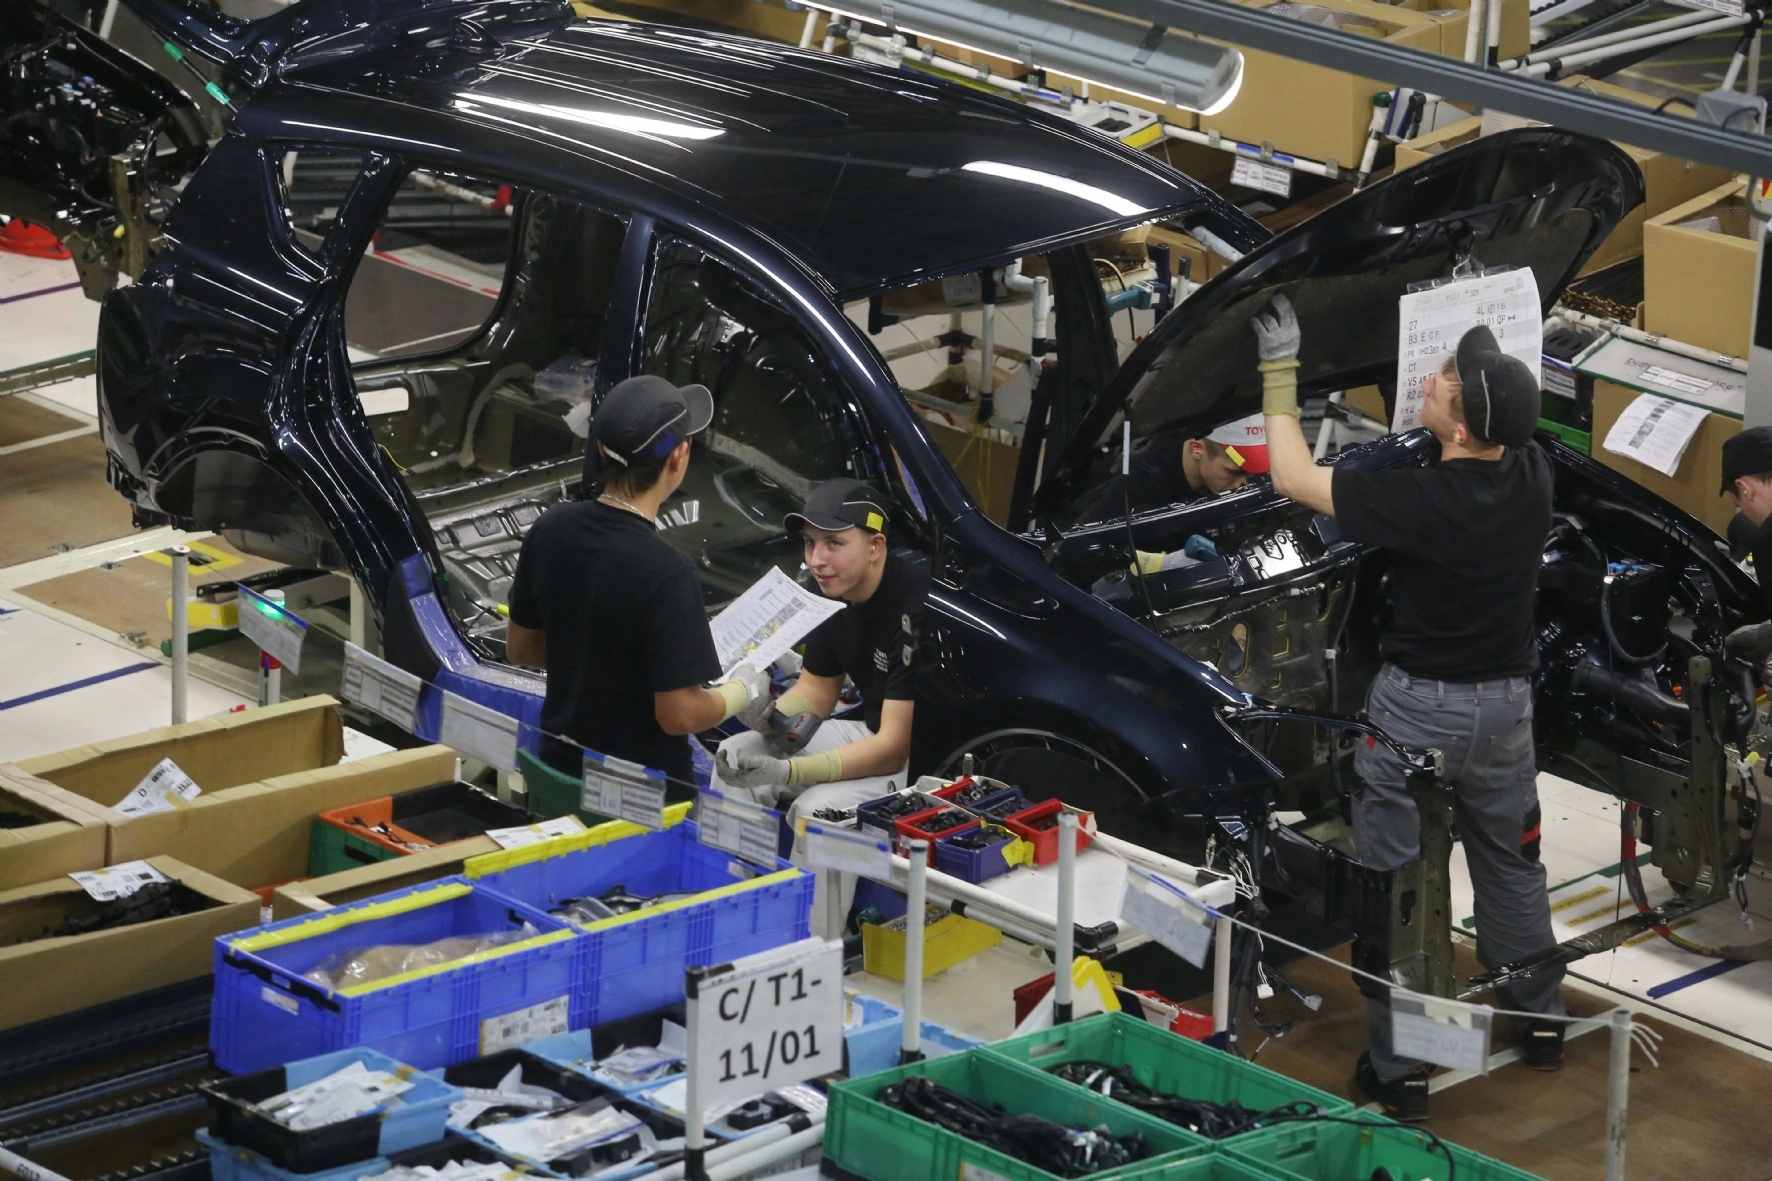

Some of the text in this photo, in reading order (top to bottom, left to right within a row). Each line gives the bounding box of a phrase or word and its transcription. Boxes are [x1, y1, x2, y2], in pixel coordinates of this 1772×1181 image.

[1409, 320, 1417, 331] 27
[1500, 328, 1504, 338] 3
[1409, 334, 1417, 344] B3
[1442, 342, 1446, 350] 4
[1409, 363, 1417, 372] CT
[1408, 376, 1417, 386] VS
[1245, 426, 1266, 435] TOY
[767, 968, 822, 1006] T1-
[719, 1024, 821, 1083] 11/01
